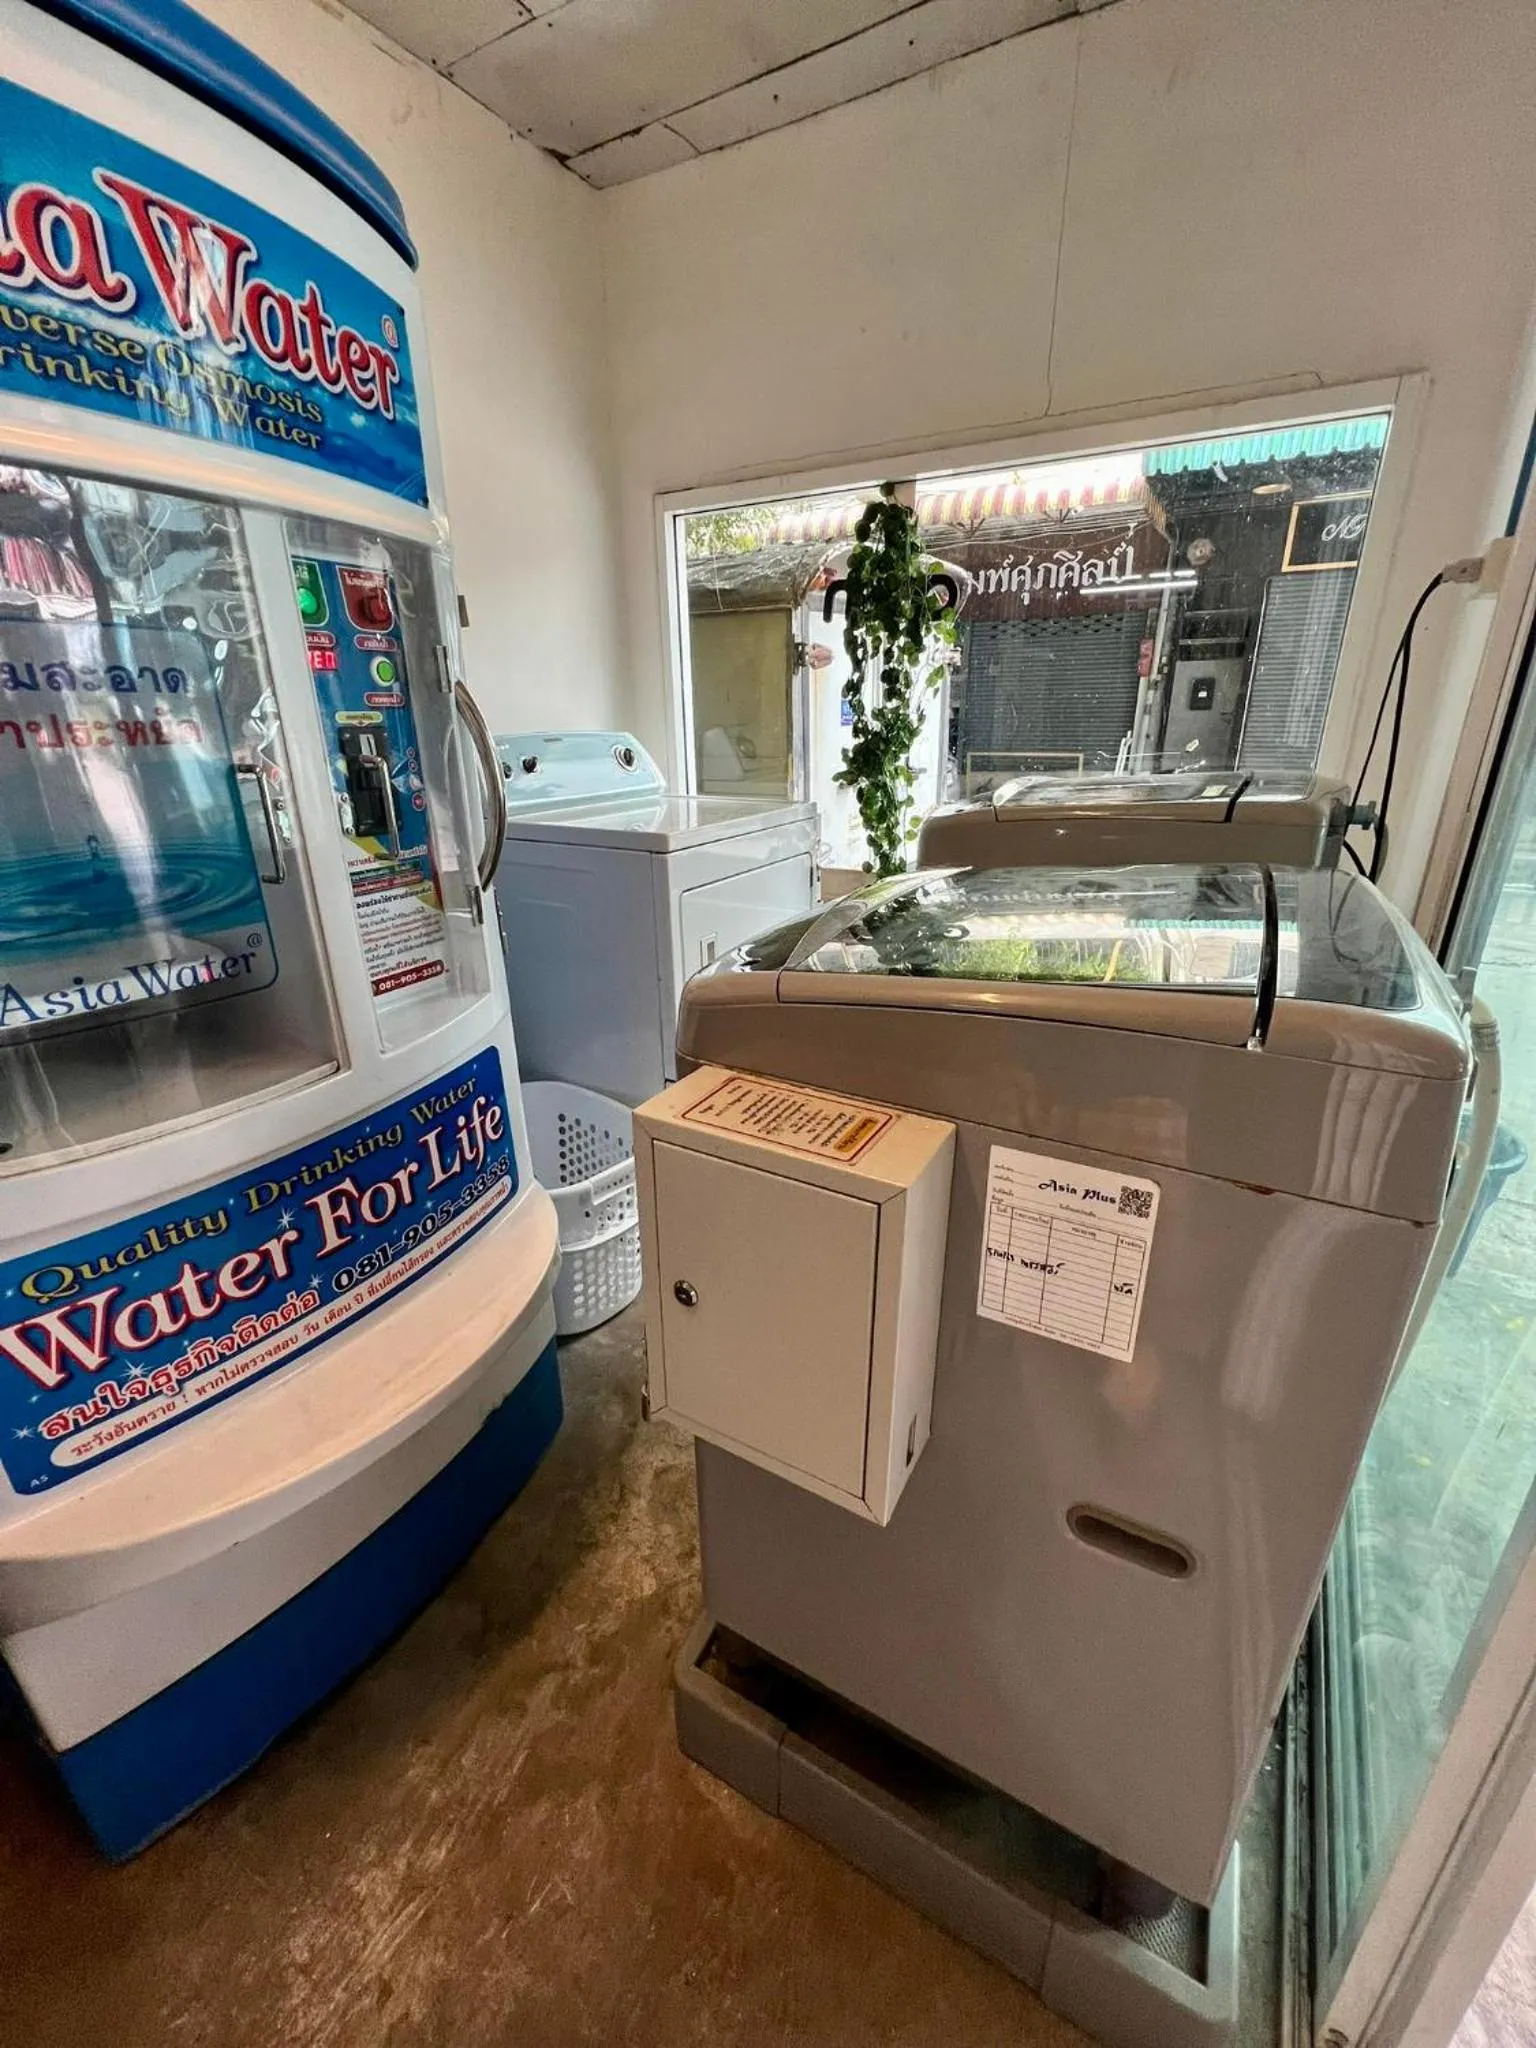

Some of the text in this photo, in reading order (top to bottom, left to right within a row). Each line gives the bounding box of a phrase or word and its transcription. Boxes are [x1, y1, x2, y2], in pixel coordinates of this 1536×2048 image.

[92, 167, 400, 421] Water
[155, 340, 322, 424] Osmosis
[0, 1094, 504, 1392] Water For Life
[20, 1076, 478, 1304] Quality Drinking Water
[38, 1156, 510, 1440] สนใจธุรกิจติดต่อ 081-905-3358
[1038, 1179, 1117, 1205] Asia Plus
[70, 1400, 176, 1457] ระวังอันตราย
